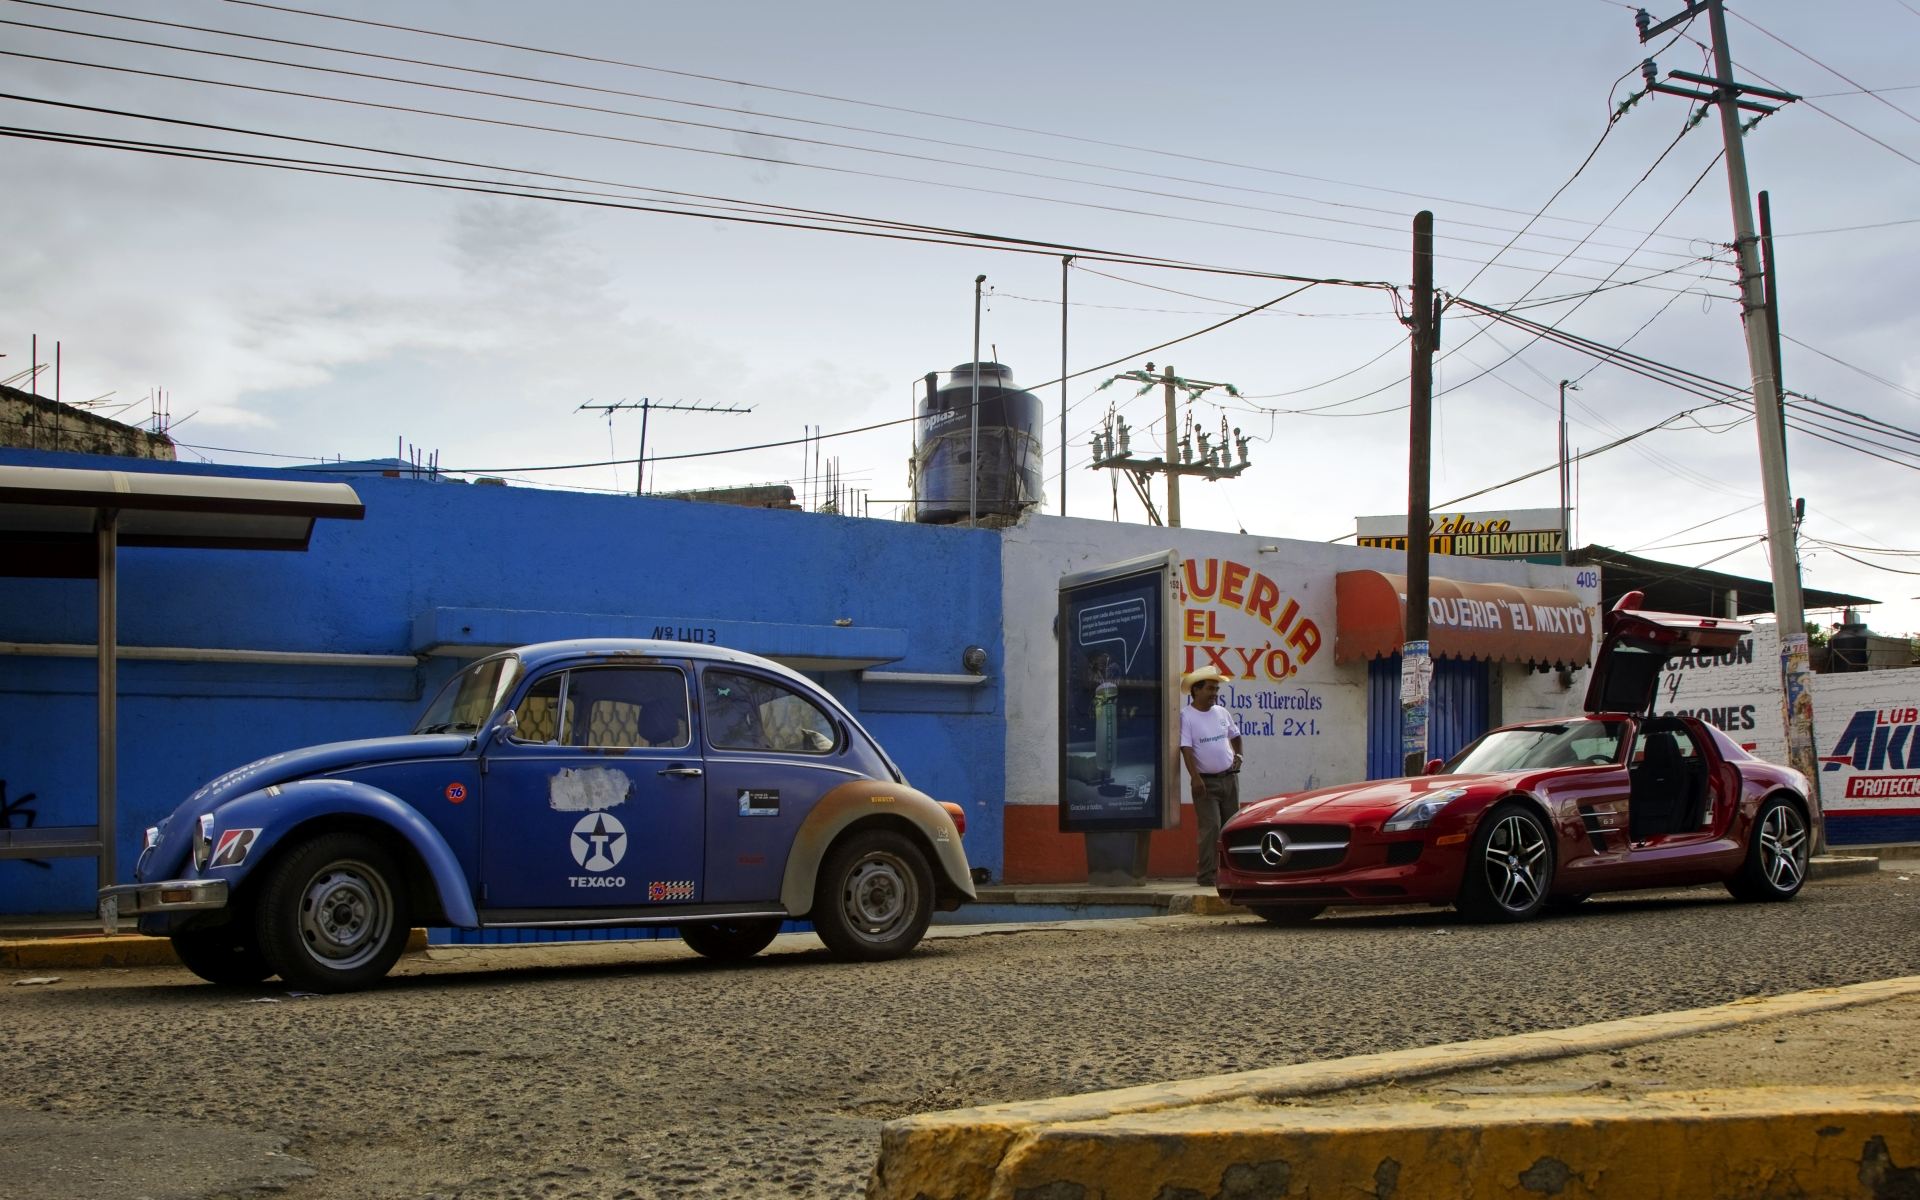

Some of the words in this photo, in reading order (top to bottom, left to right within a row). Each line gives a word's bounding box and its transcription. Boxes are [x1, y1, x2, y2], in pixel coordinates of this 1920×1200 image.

[1455, 532, 1564, 556] AUTOMOTRIZ
[1577, 572, 1597, 588] 403
[1180, 558, 1321, 665] UERIA
[1400, 593, 1502, 629] QUERIA
[1184, 609, 1225, 642] EL
[1229, 685, 1252, 709] los
[1254, 688, 1322, 711] Miercoles
[450, 787, 464, 798] 76
[568, 876, 626, 888] TEXACO
